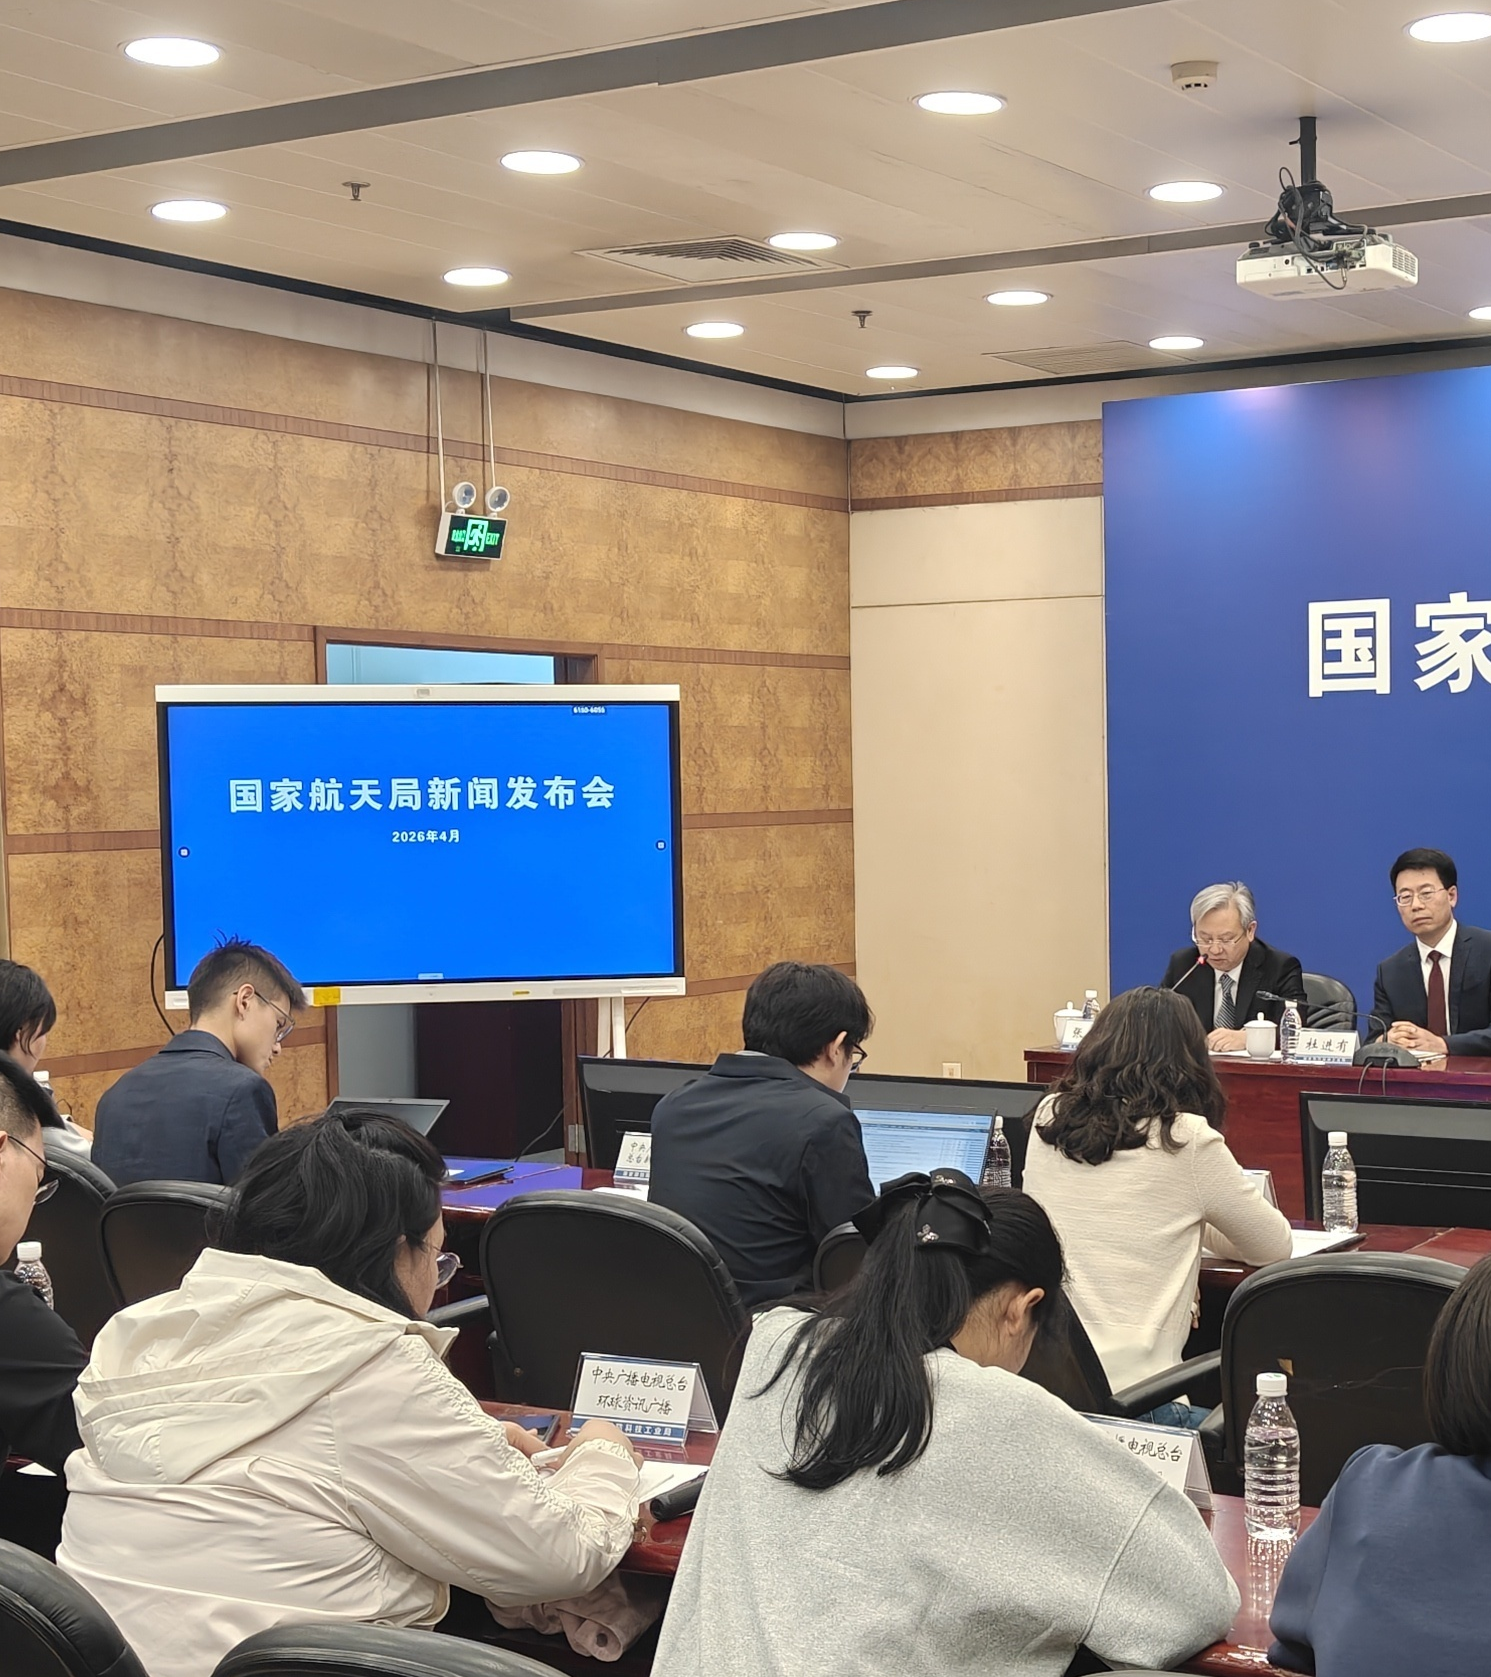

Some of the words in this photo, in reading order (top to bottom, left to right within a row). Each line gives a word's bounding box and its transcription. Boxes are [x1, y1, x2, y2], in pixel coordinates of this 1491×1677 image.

[485, 532, 500, 546] EXIT
[228, 775, 616, 814] 国家航天局新闻发布会
[391, 828, 461, 845] 2026年4月
[591, 1366, 688, 1391] 中央广播电视总台
[596, 1394, 672, 1415] 环球资讯广播
